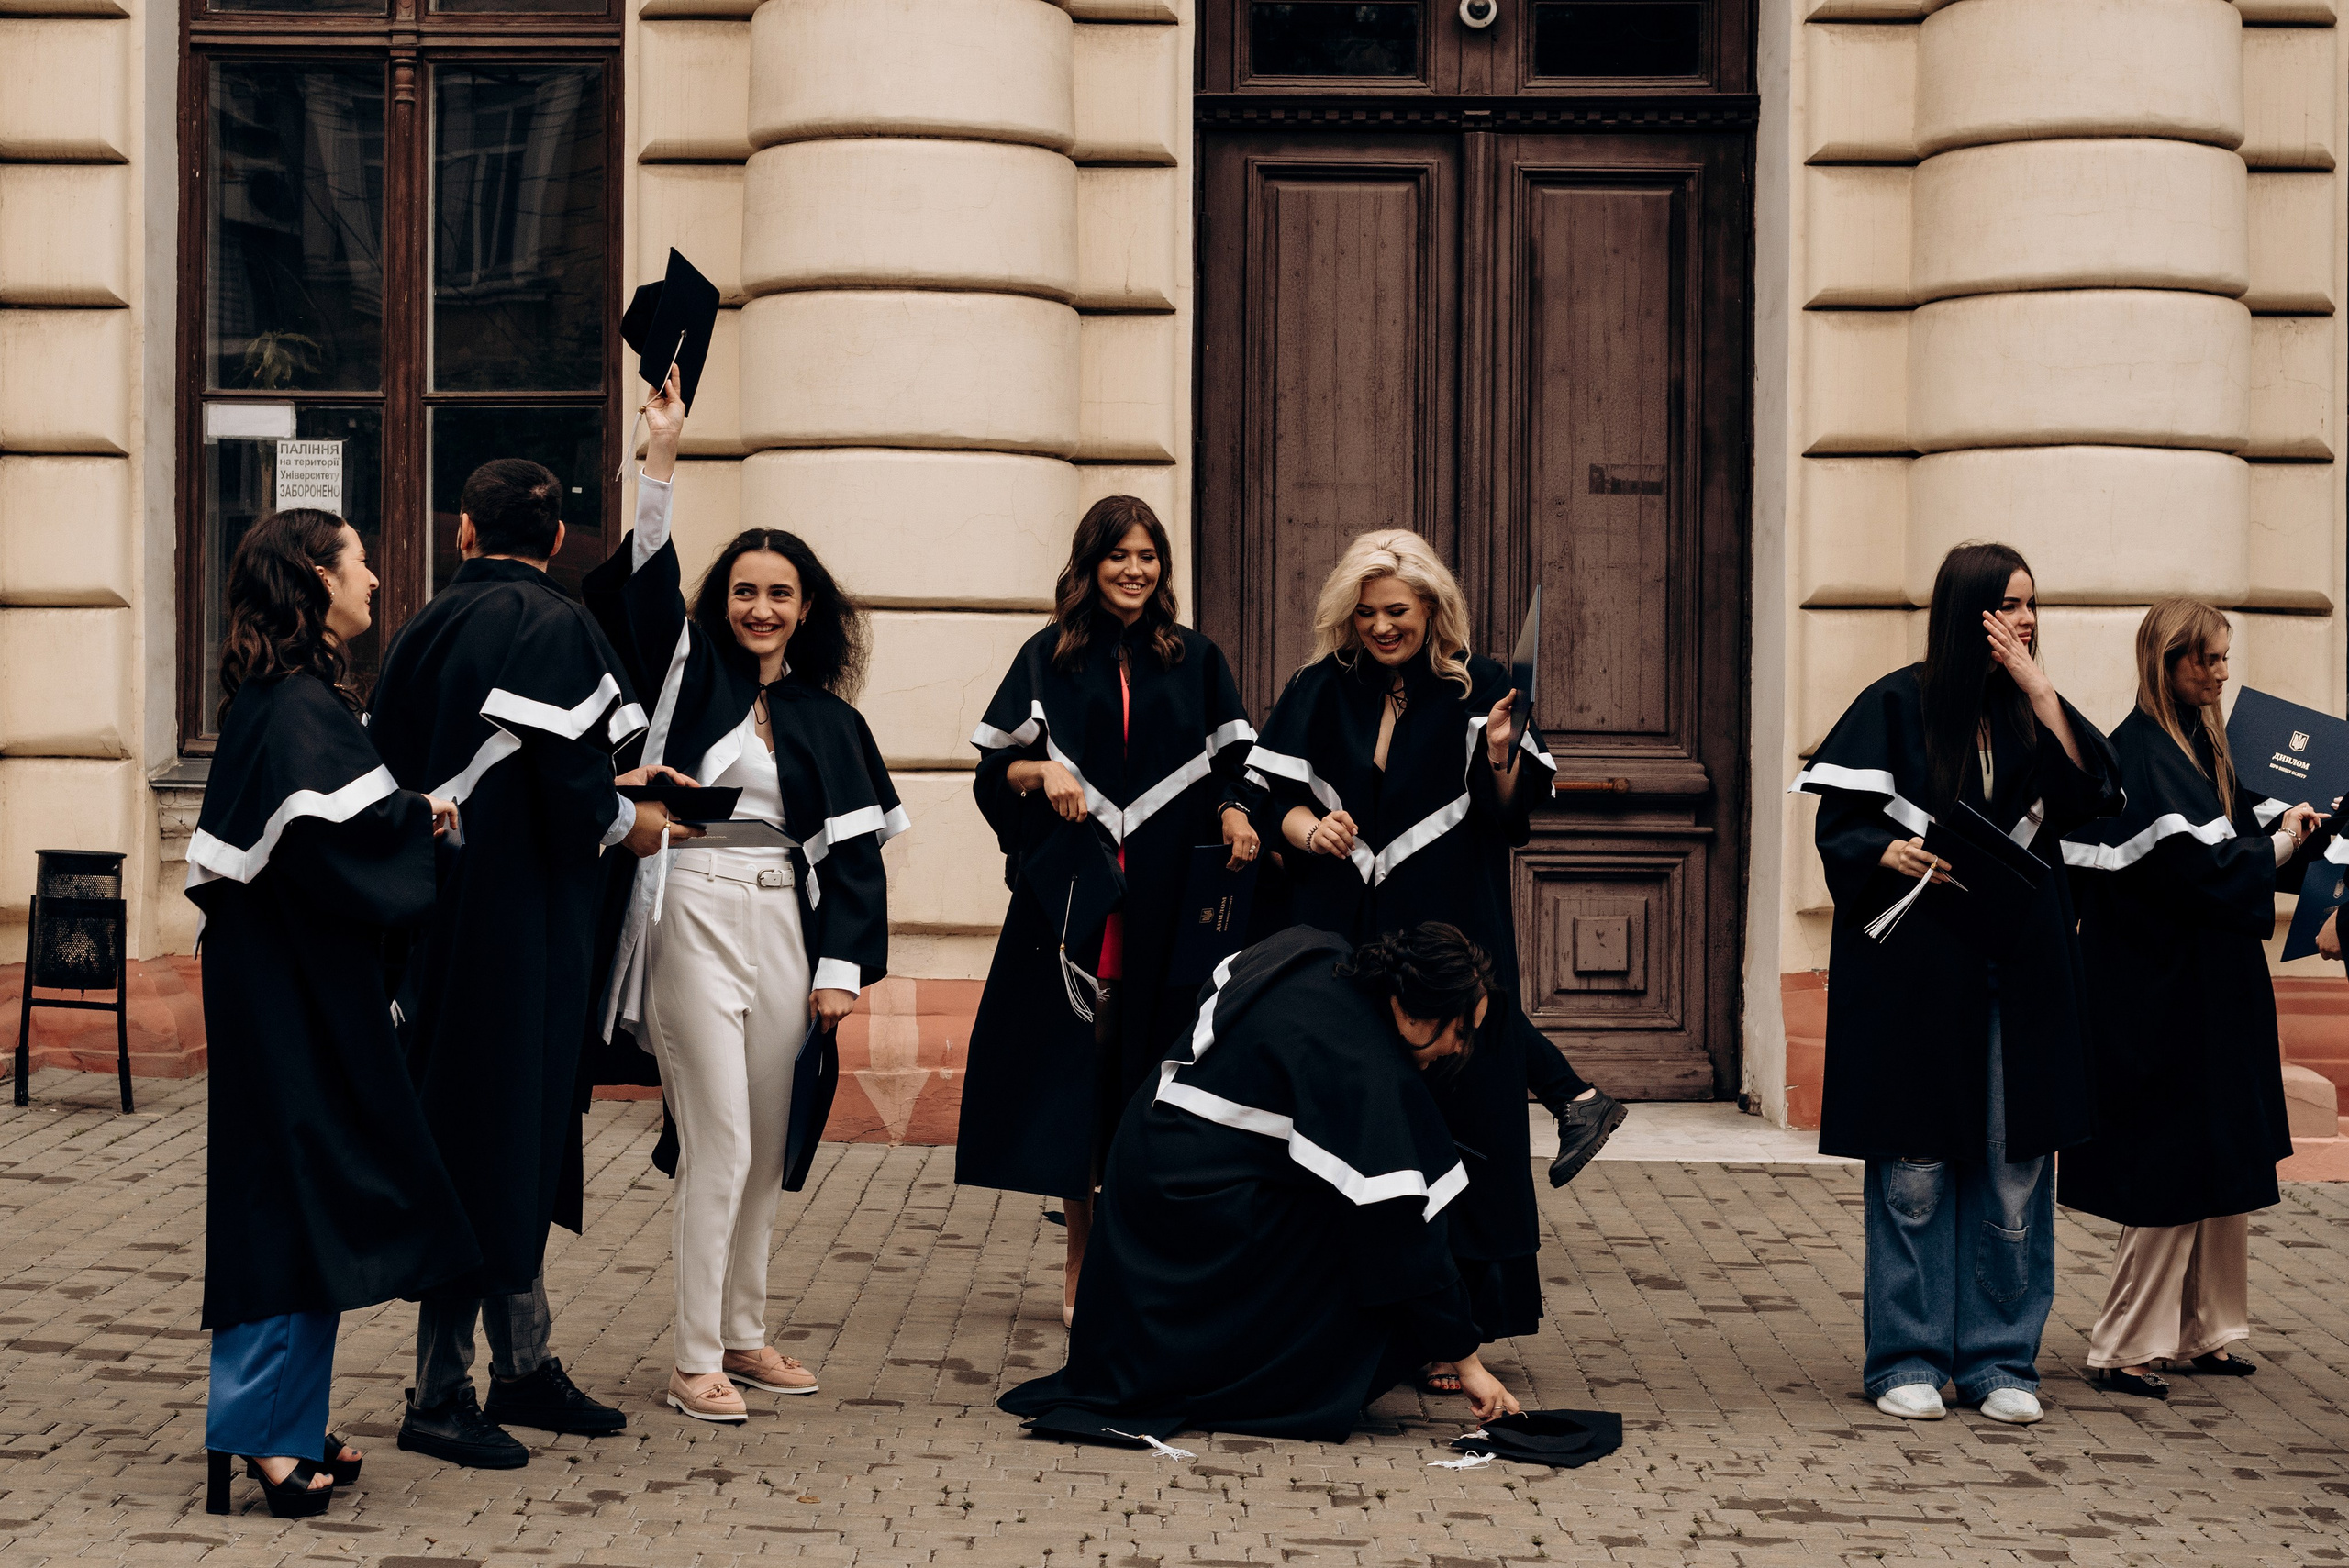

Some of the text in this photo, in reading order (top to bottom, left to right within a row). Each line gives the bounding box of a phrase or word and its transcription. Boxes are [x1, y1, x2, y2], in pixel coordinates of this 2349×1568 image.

[280, 443, 340, 455] ПАЛІННЯ
[294, 457, 340, 468] території
[280, 470, 340, 482] Університету
[280, 484, 340, 497] ЗАБОРОНЕНО
[2272, 752, 2310, 770] ДИПЛОМ
[1216, 896, 1227, 932] ДИПЛОМ
